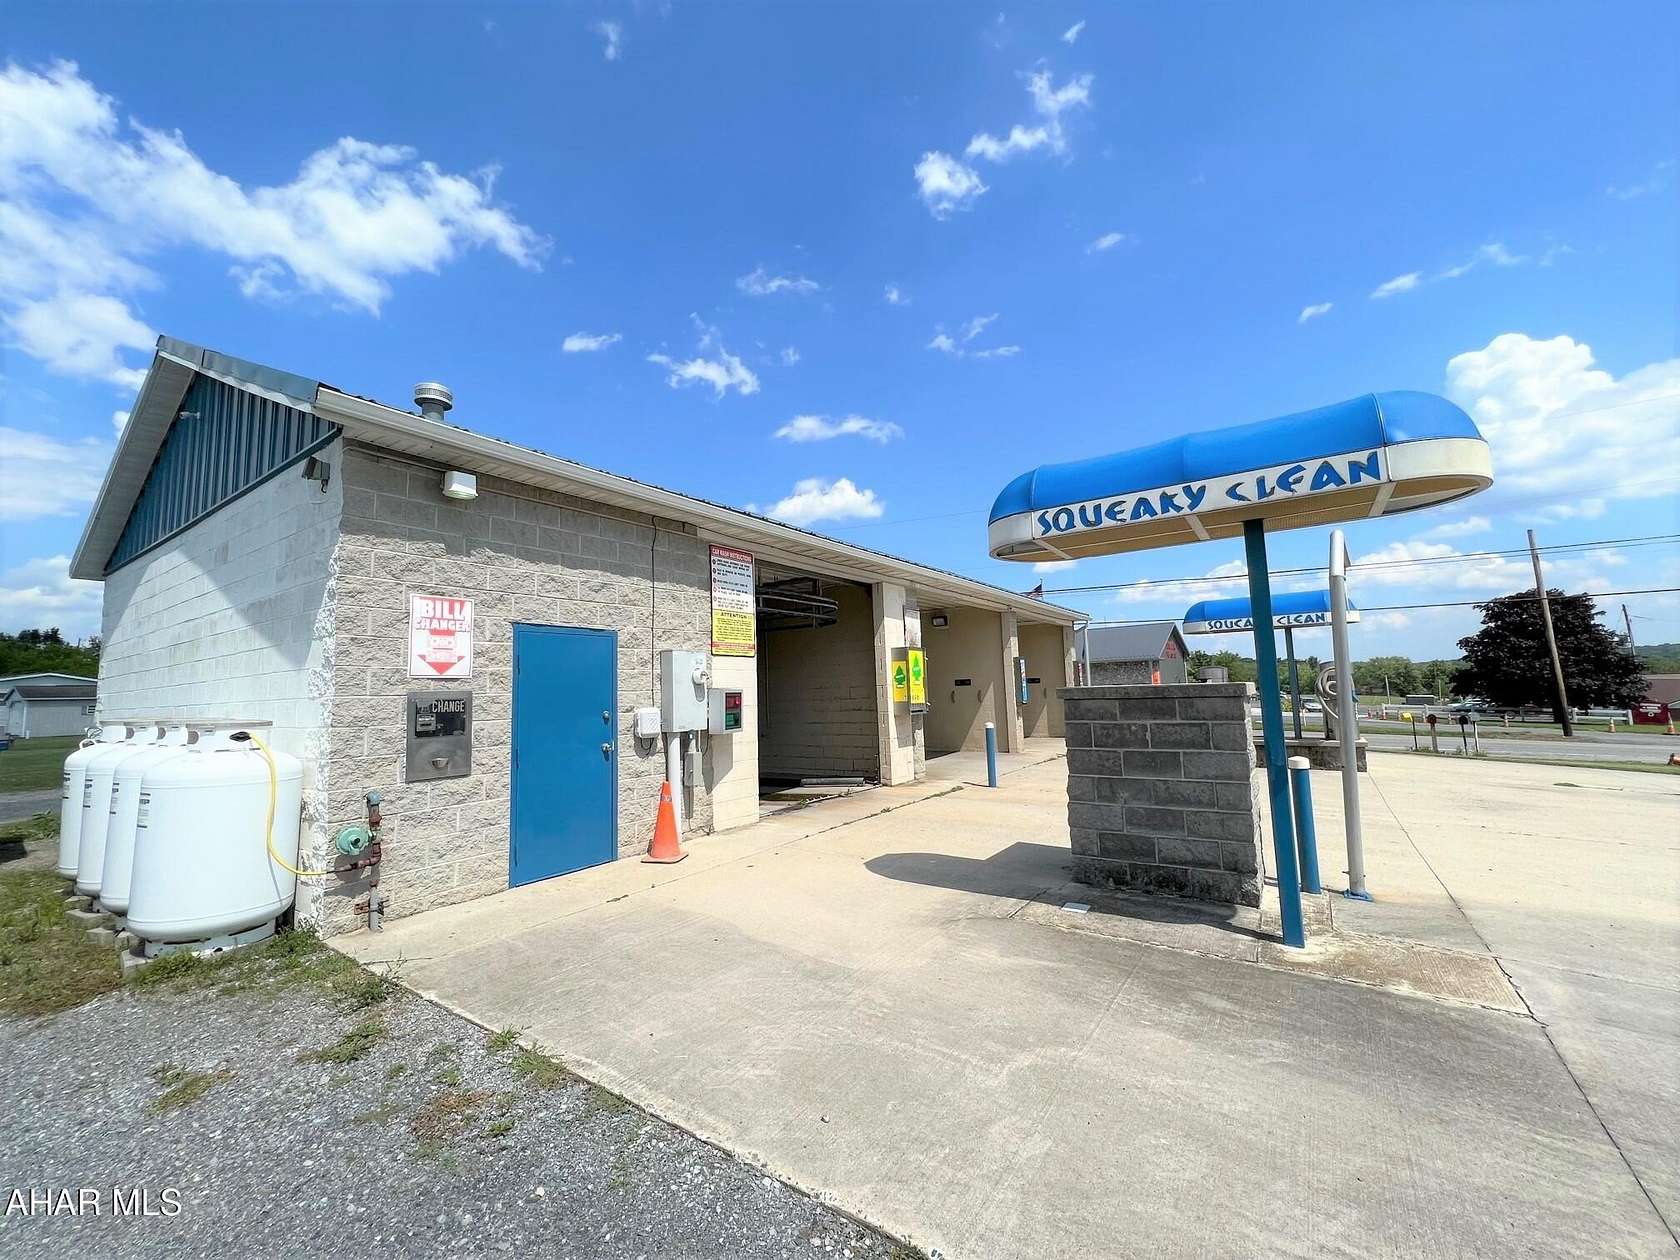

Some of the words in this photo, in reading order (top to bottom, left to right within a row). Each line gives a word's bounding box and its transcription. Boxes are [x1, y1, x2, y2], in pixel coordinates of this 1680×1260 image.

[1037, 484, 1206, 537] SQUEAKY
[1225, 450, 1381, 502] CLEAN
[421, 599, 466, 620] BILL
[415, 618, 470, 633] CHANGER
[432, 700, 465, 713] CHANGE
